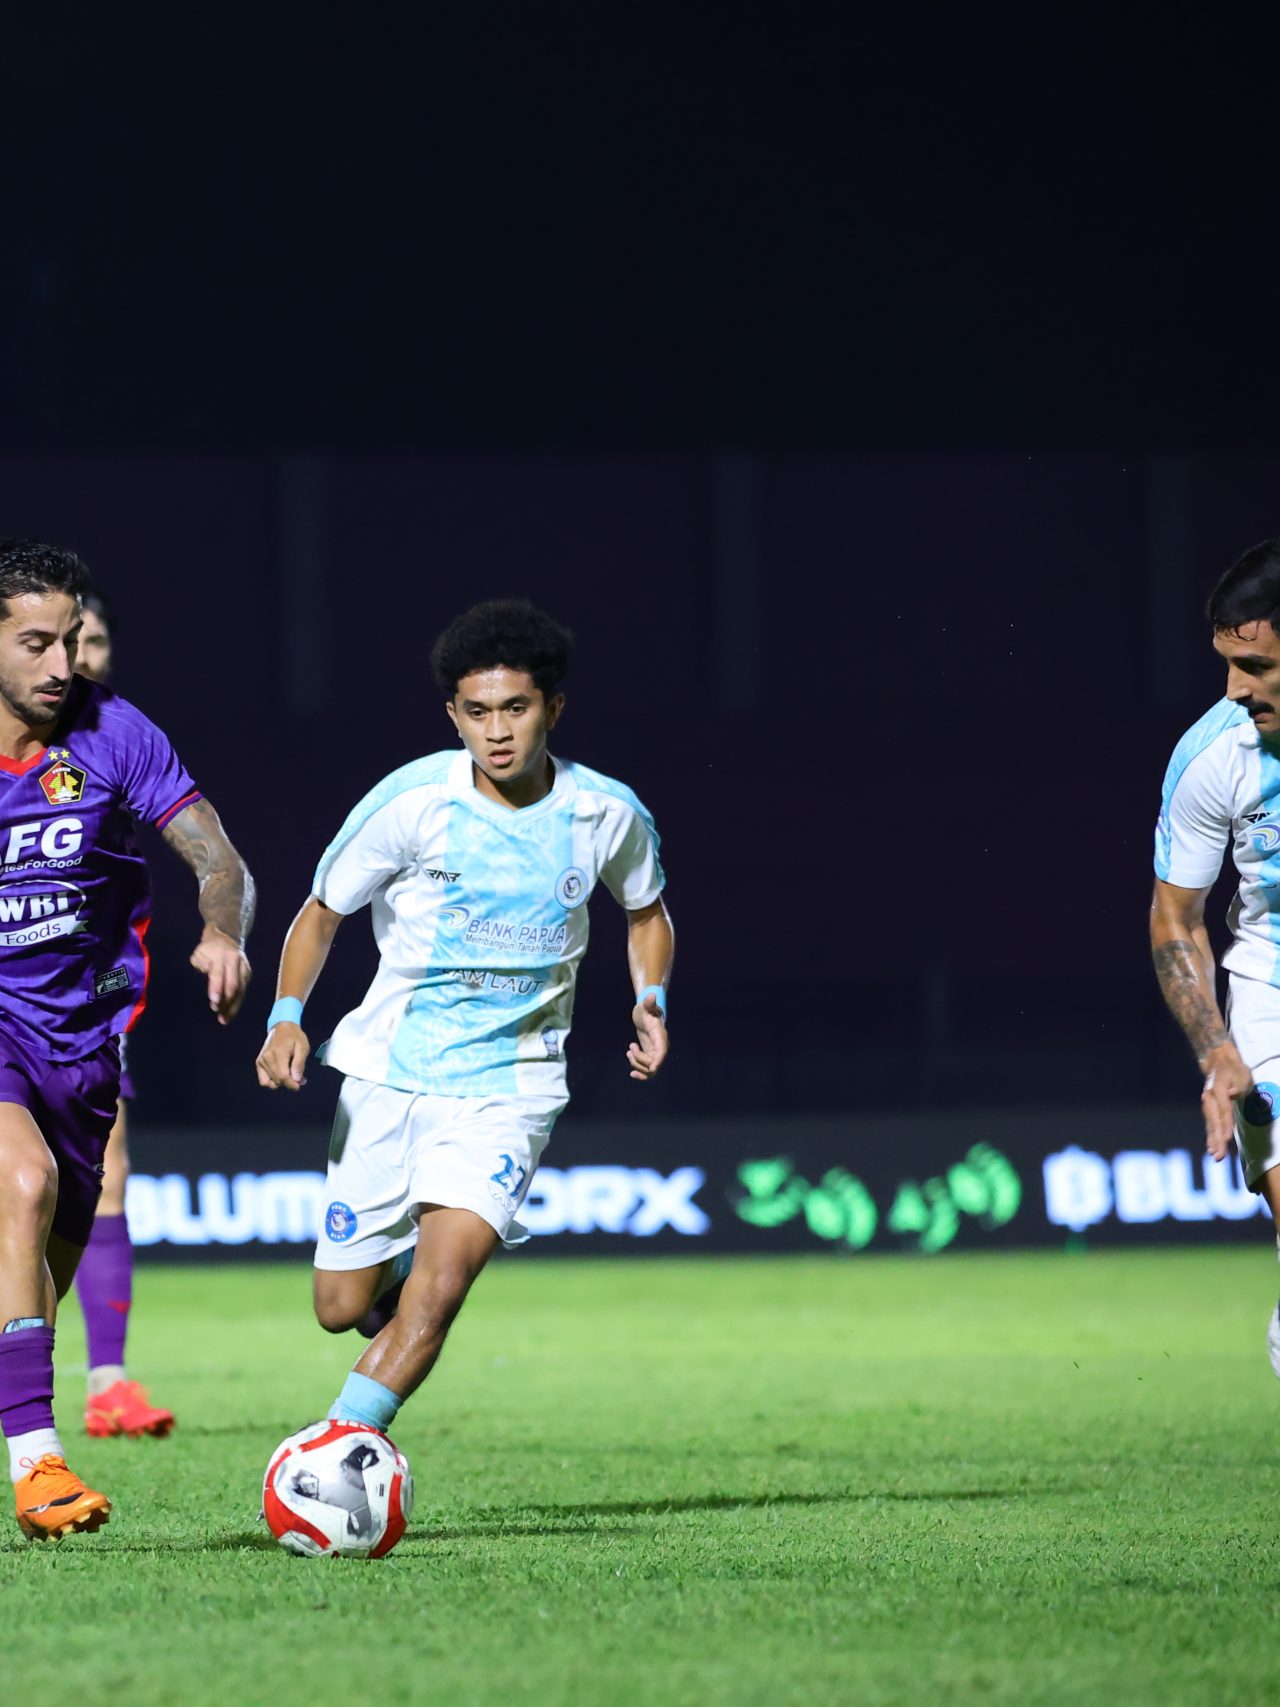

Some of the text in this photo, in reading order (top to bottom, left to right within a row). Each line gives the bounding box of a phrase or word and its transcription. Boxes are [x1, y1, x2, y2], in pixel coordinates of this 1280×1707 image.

[5, 923, 61, 945] Foods
[468, 920, 566, 942] BANK PAPUA
[465, 934, 562, 954] Membangun Tanah Papua
[1114, 1148, 1274, 1226] BLU
[124, 1170, 328, 1247] BLUM
